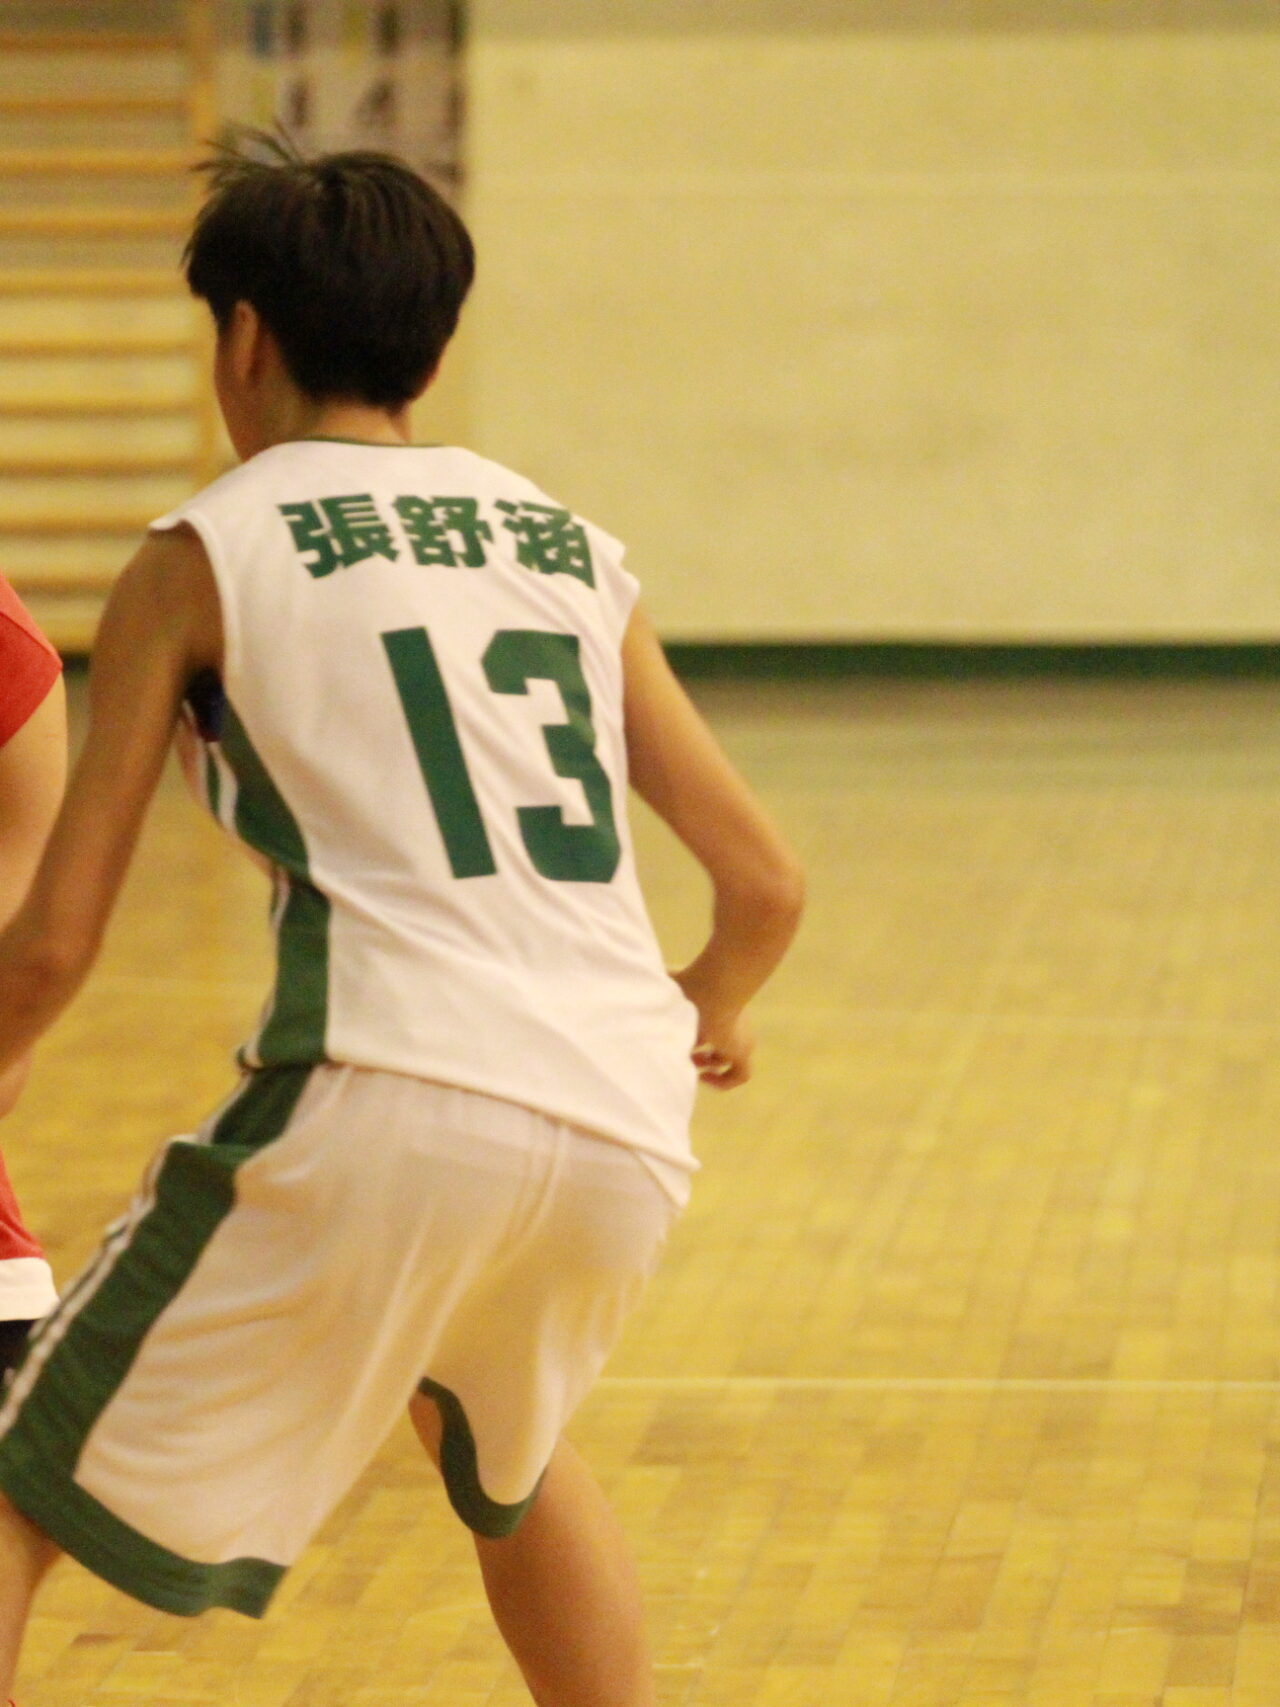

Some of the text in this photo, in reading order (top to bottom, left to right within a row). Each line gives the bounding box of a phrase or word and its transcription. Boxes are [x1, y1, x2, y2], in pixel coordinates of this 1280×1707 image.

[276, 493, 597, 591] 張舒涵
[380, 625, 620, 884] 13
